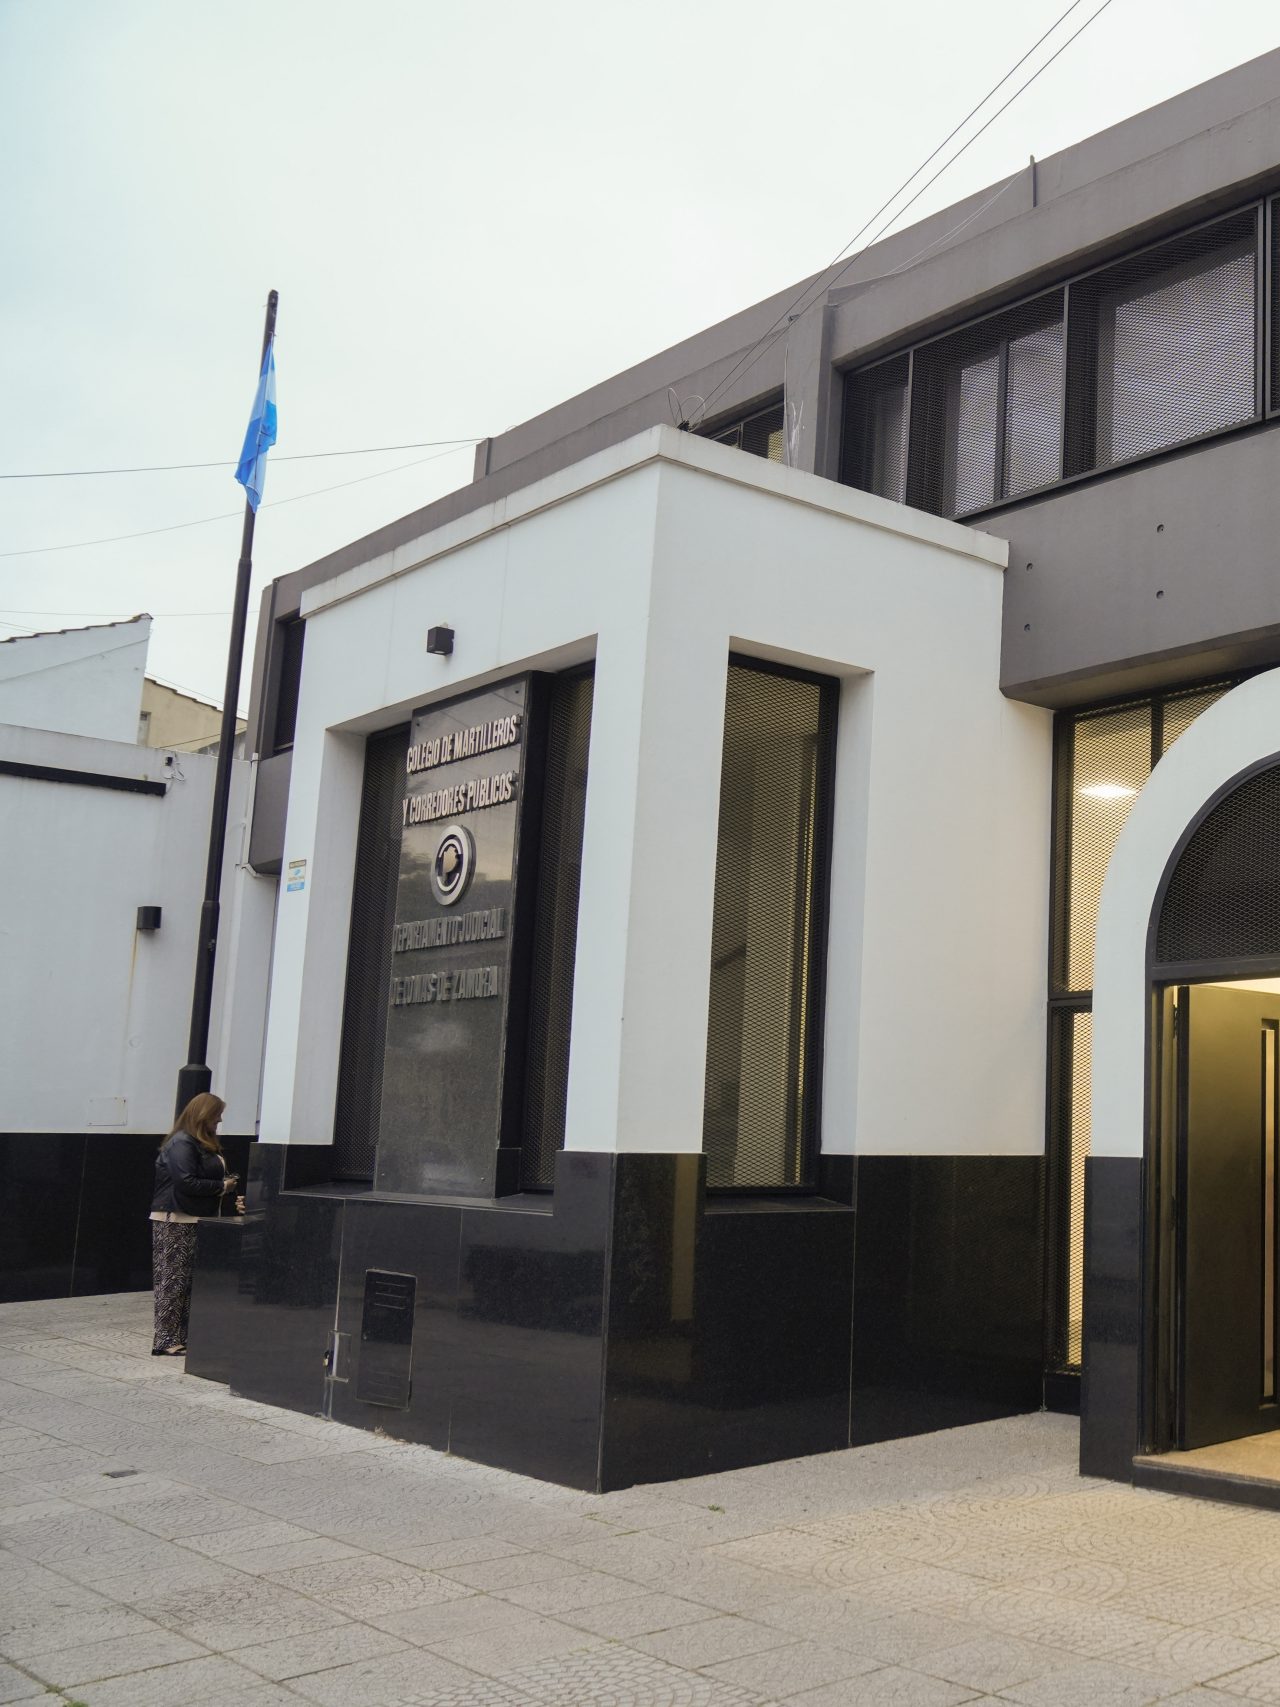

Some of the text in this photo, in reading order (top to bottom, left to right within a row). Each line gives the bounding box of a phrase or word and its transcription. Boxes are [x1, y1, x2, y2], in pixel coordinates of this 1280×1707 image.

[406, 714, 517, 773] COLEGIO DE MARTILLEROS
[402, 798, 409, 826] Y
[409, 783, 465, 823] CORREDORES
